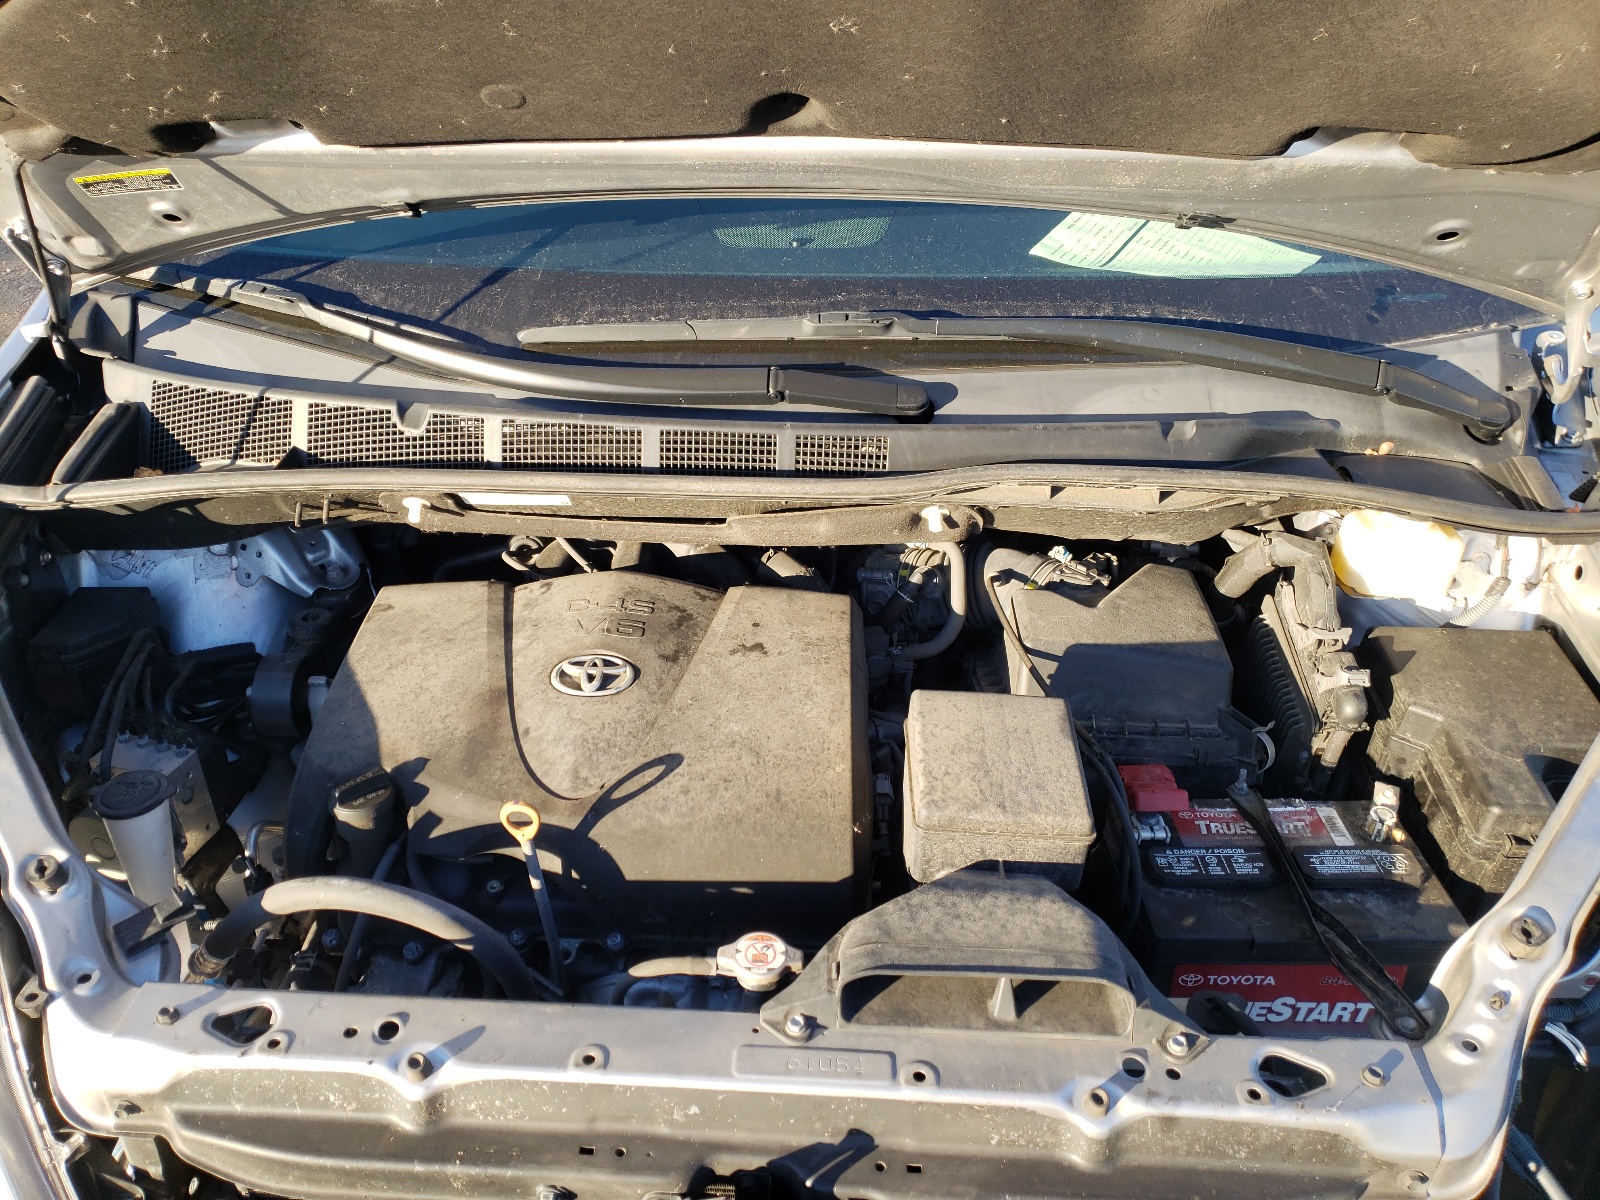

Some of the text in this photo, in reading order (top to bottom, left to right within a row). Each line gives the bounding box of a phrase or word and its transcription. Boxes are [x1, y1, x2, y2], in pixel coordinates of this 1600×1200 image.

[566, 617, 647, 639] V6
[1194, 811, 1237, 819] TOYOTA
[1207, 975, 1276, 986] TOYOTA
